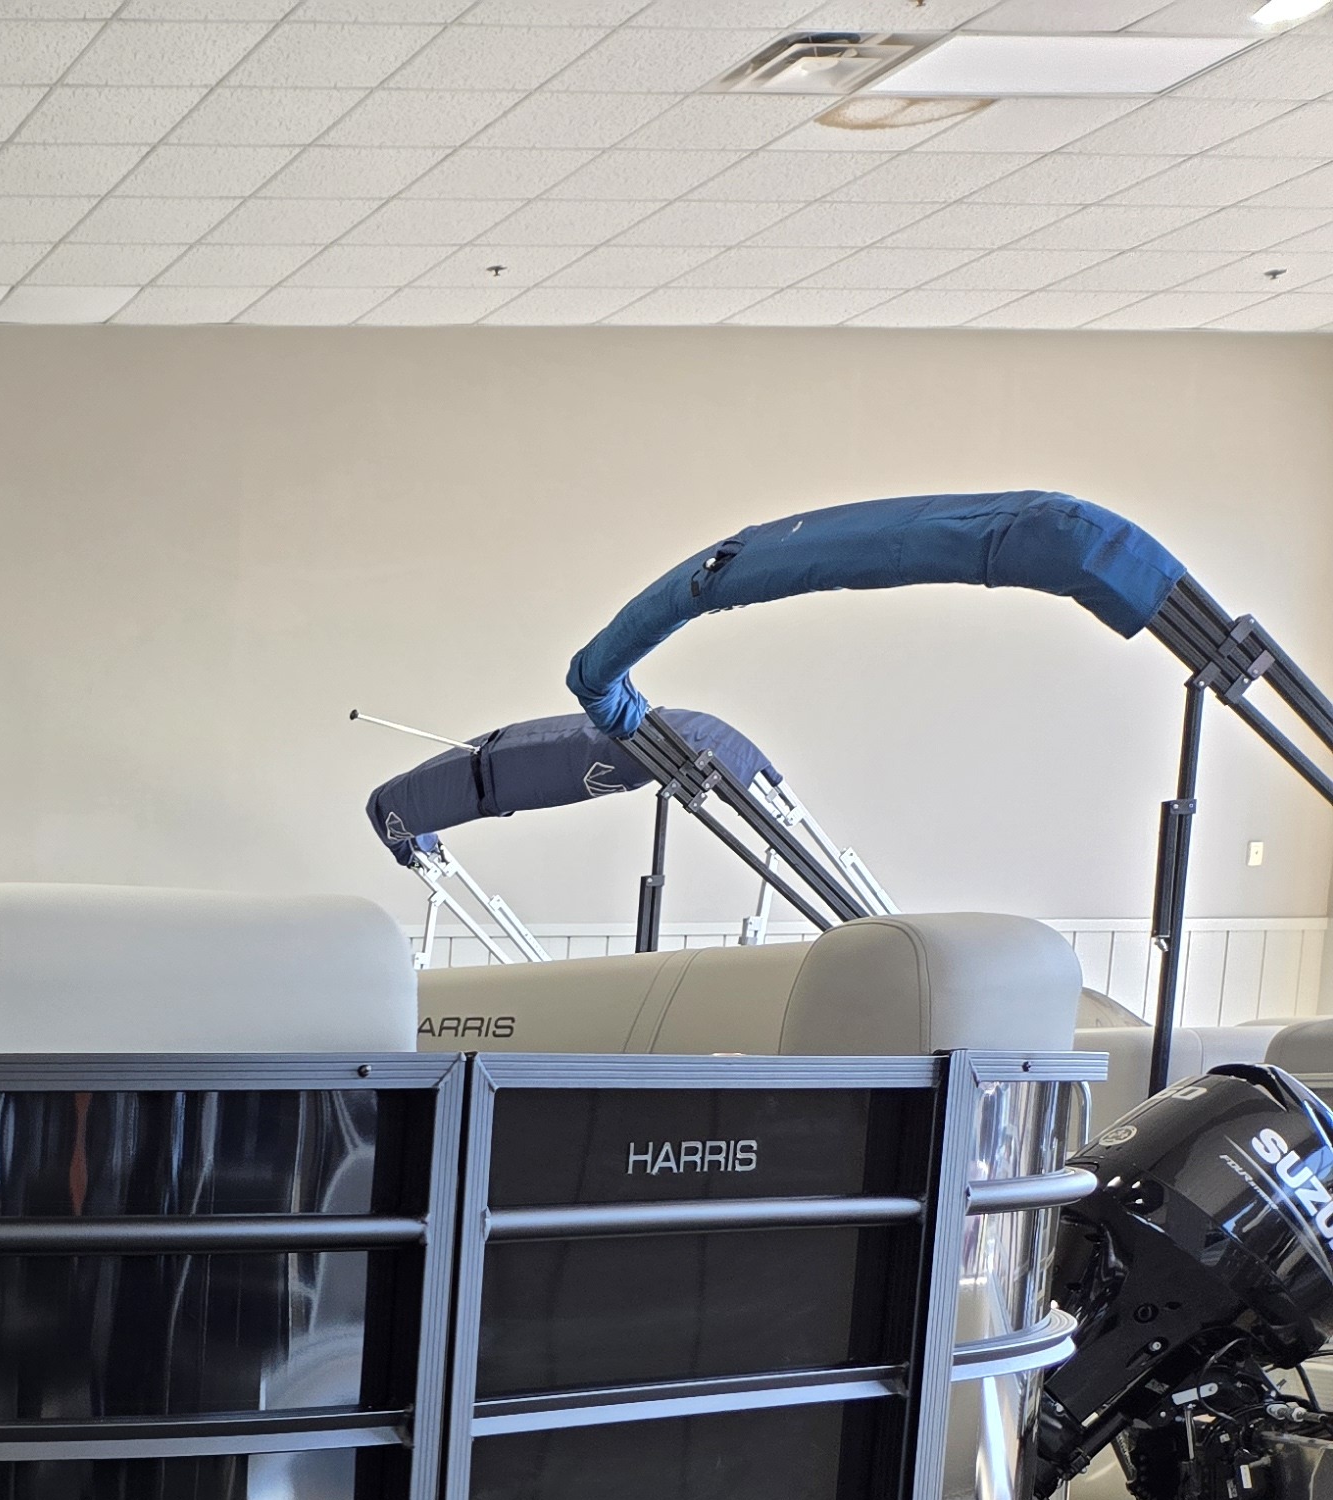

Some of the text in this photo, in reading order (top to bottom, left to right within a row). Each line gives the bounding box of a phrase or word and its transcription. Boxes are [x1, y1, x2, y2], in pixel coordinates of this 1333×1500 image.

[418, 1016, 516, 1038] ARRIS
[627, 1139, 758, 1175] HARRIS
[1251, 1127, 1333, 1252] SUZU
